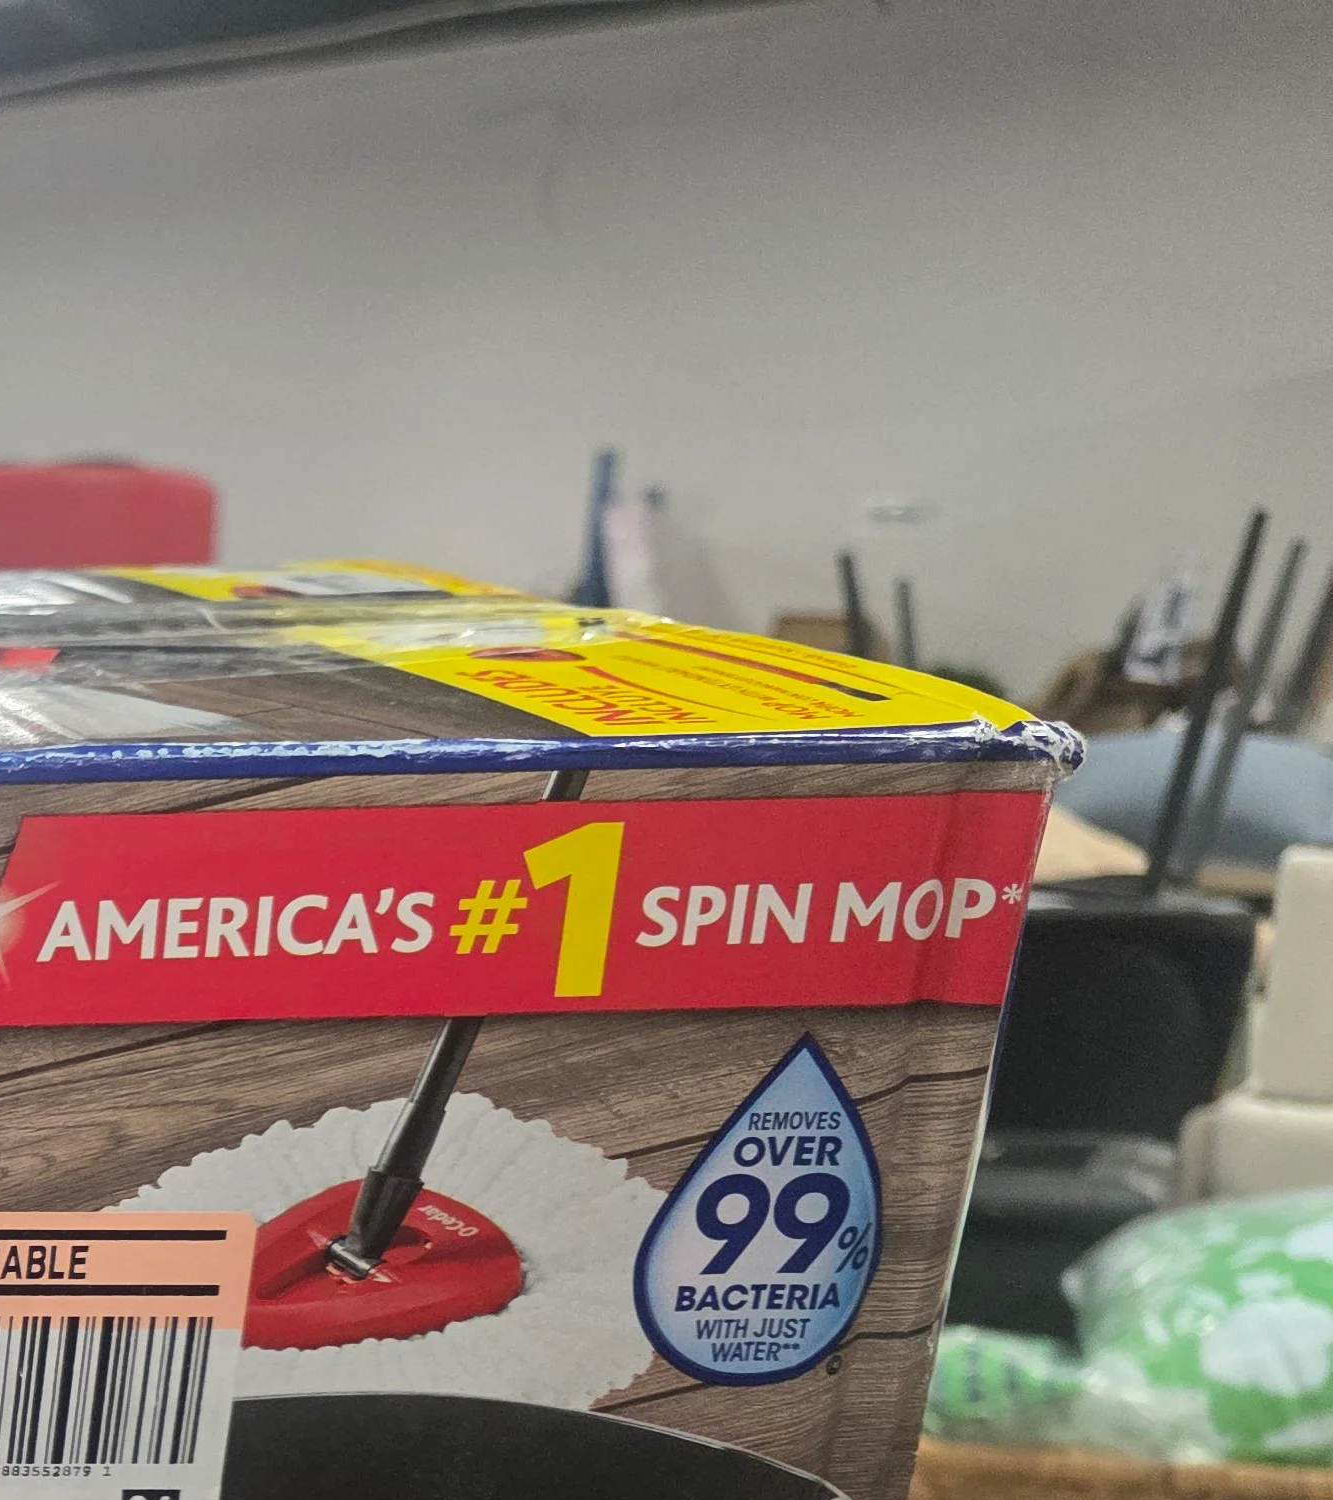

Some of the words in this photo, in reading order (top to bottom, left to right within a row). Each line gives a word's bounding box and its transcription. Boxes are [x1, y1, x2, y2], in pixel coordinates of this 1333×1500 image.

[455, 669, 666, 726] INCLUDES
[36, 886, 435, 963] AMERICA'S
[449, 821, 626, 998] #1
[636, 881, 815, 948] SPIN
[748, 1110, 843, 1131] REMOVES
[733, 1135, 844, 1168] OVER
[416, 1204, 479, 1238] O-Cedar
[674, 1281, 842, 1313] BACTERIA
[696, 1319, 750, 1340] WITH
[753, 1318, 811, 1339] JUST
[1, 1466, 91, 1477] 883552879
[102, 1466, 112, 1477] 1
